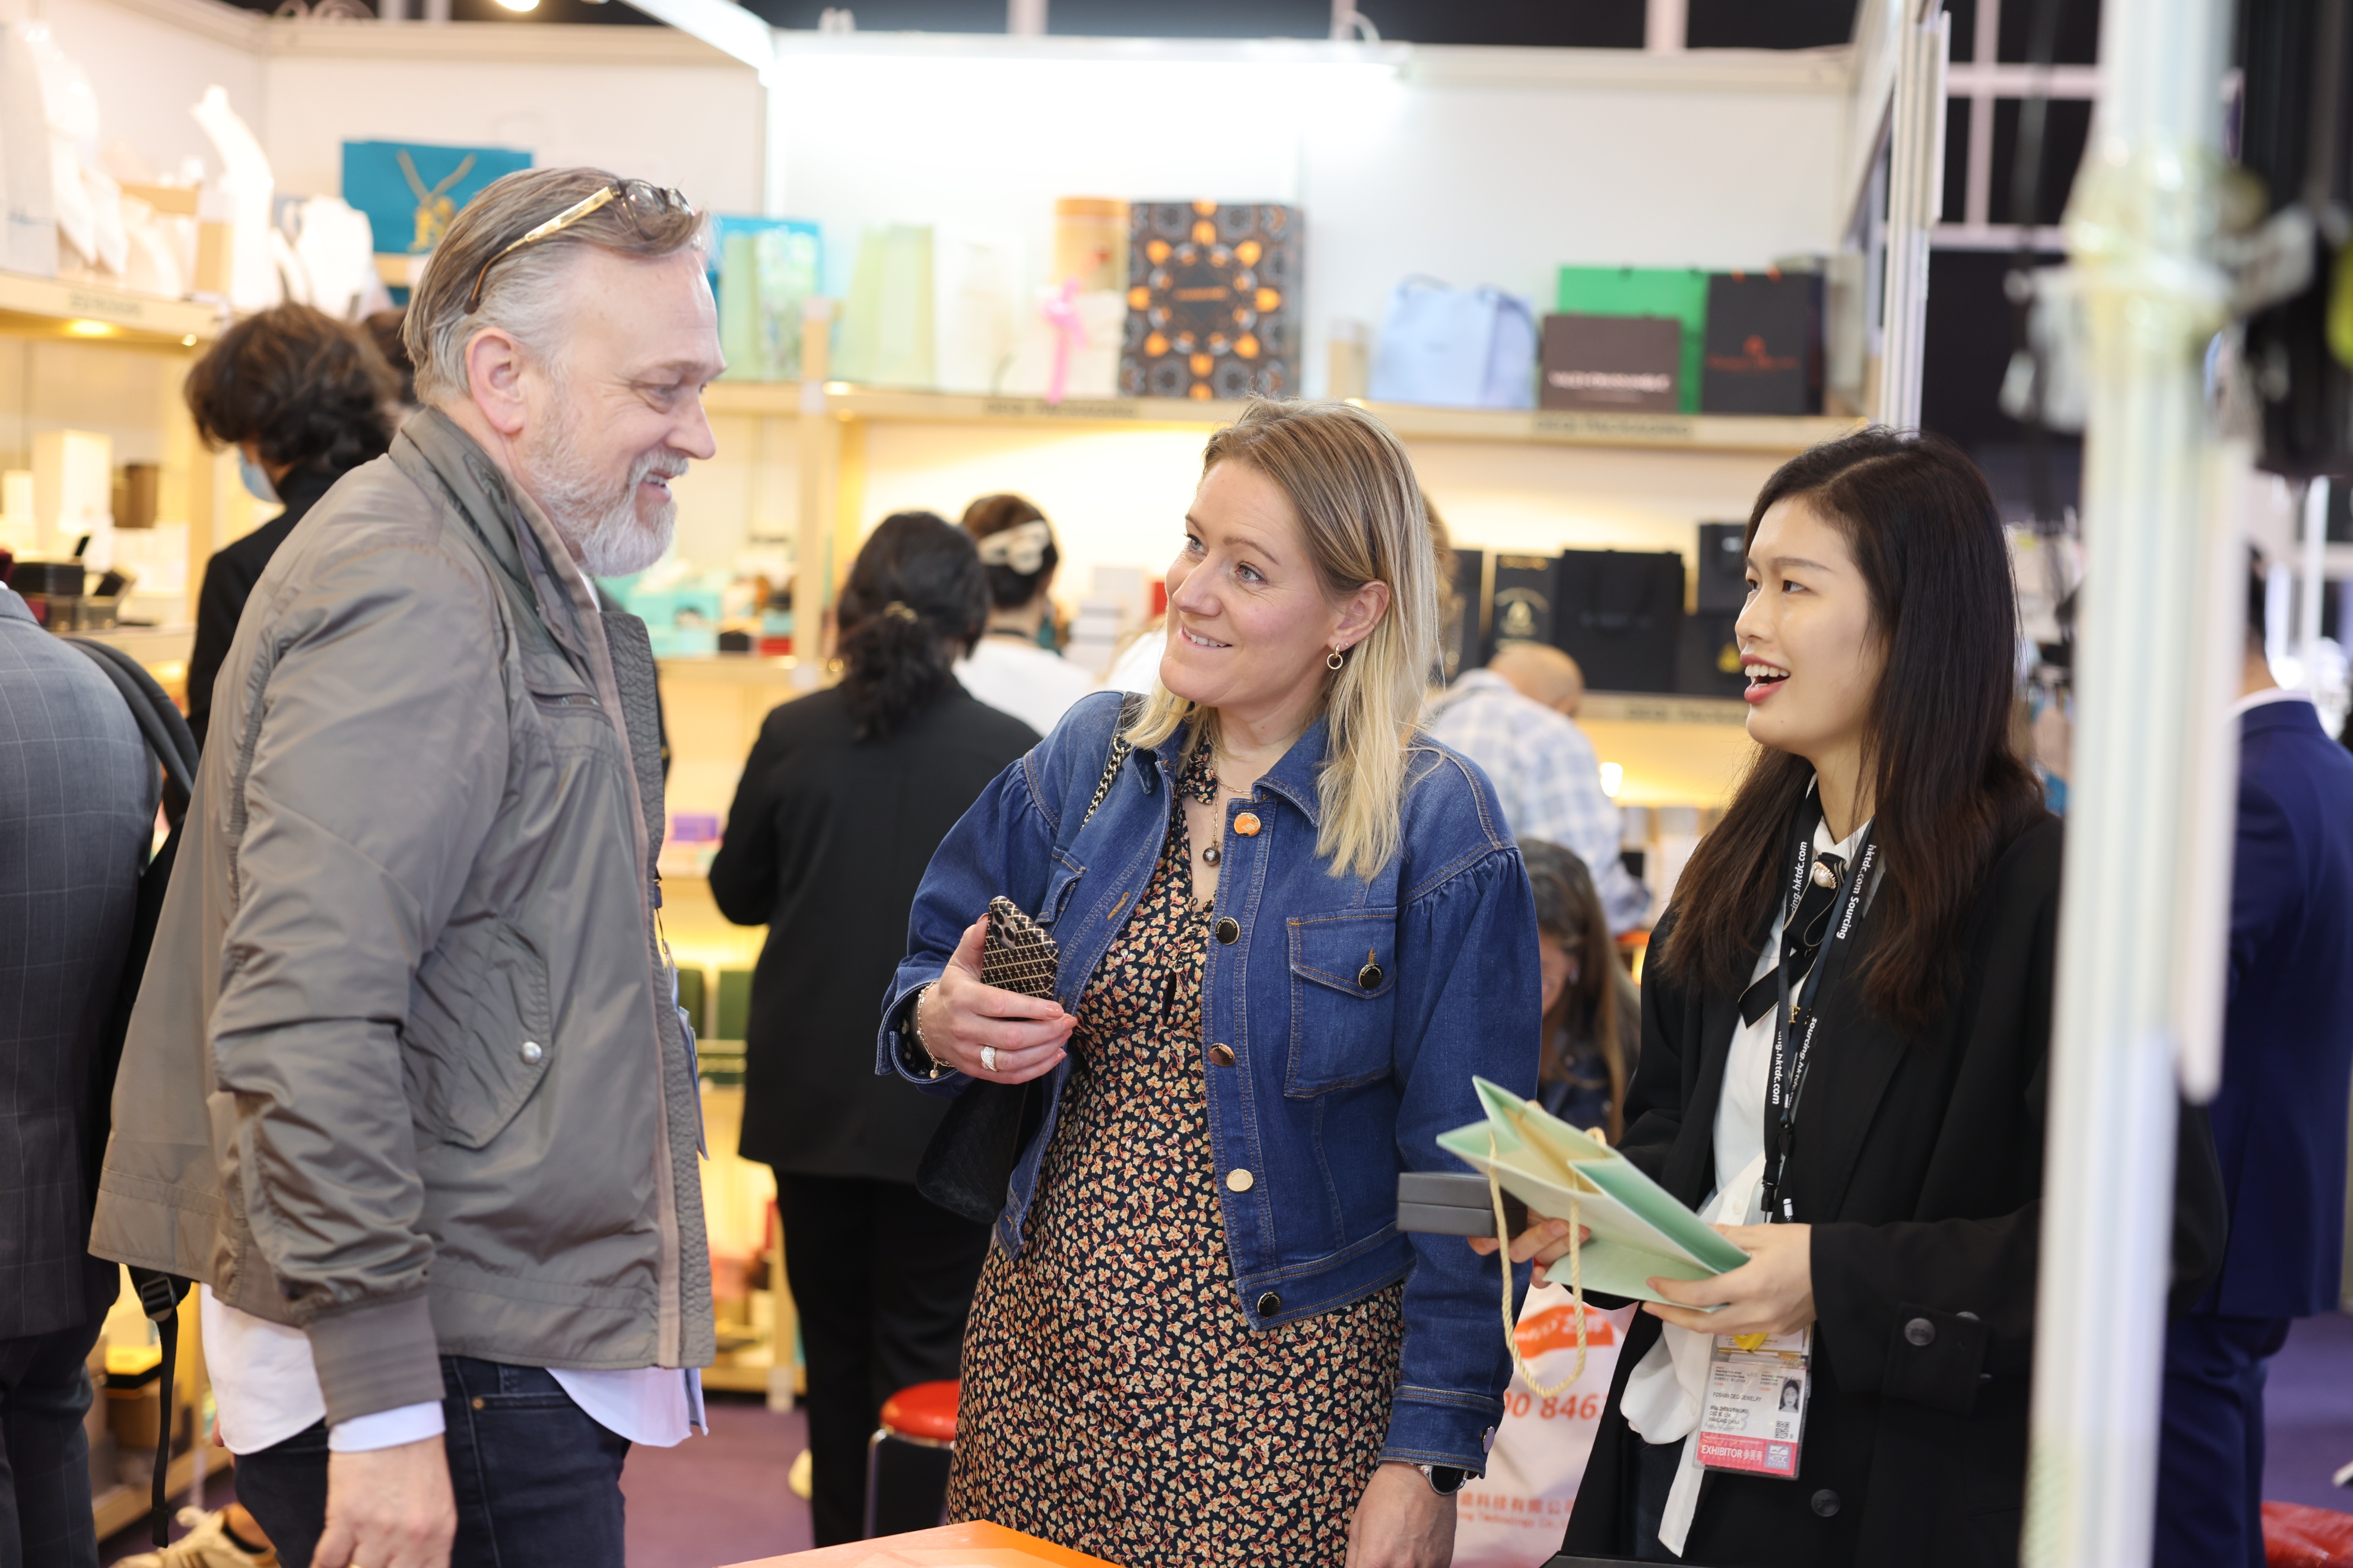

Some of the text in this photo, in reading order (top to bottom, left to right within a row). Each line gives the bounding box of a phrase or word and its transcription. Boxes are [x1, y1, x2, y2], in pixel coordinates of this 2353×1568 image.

[1836, 844, 1877, 940] hktdc.com Sourcing
[1539, 1394, 1608, 1420] 846
[1701, 1445, 1743, 1459] EXHIBITOR
